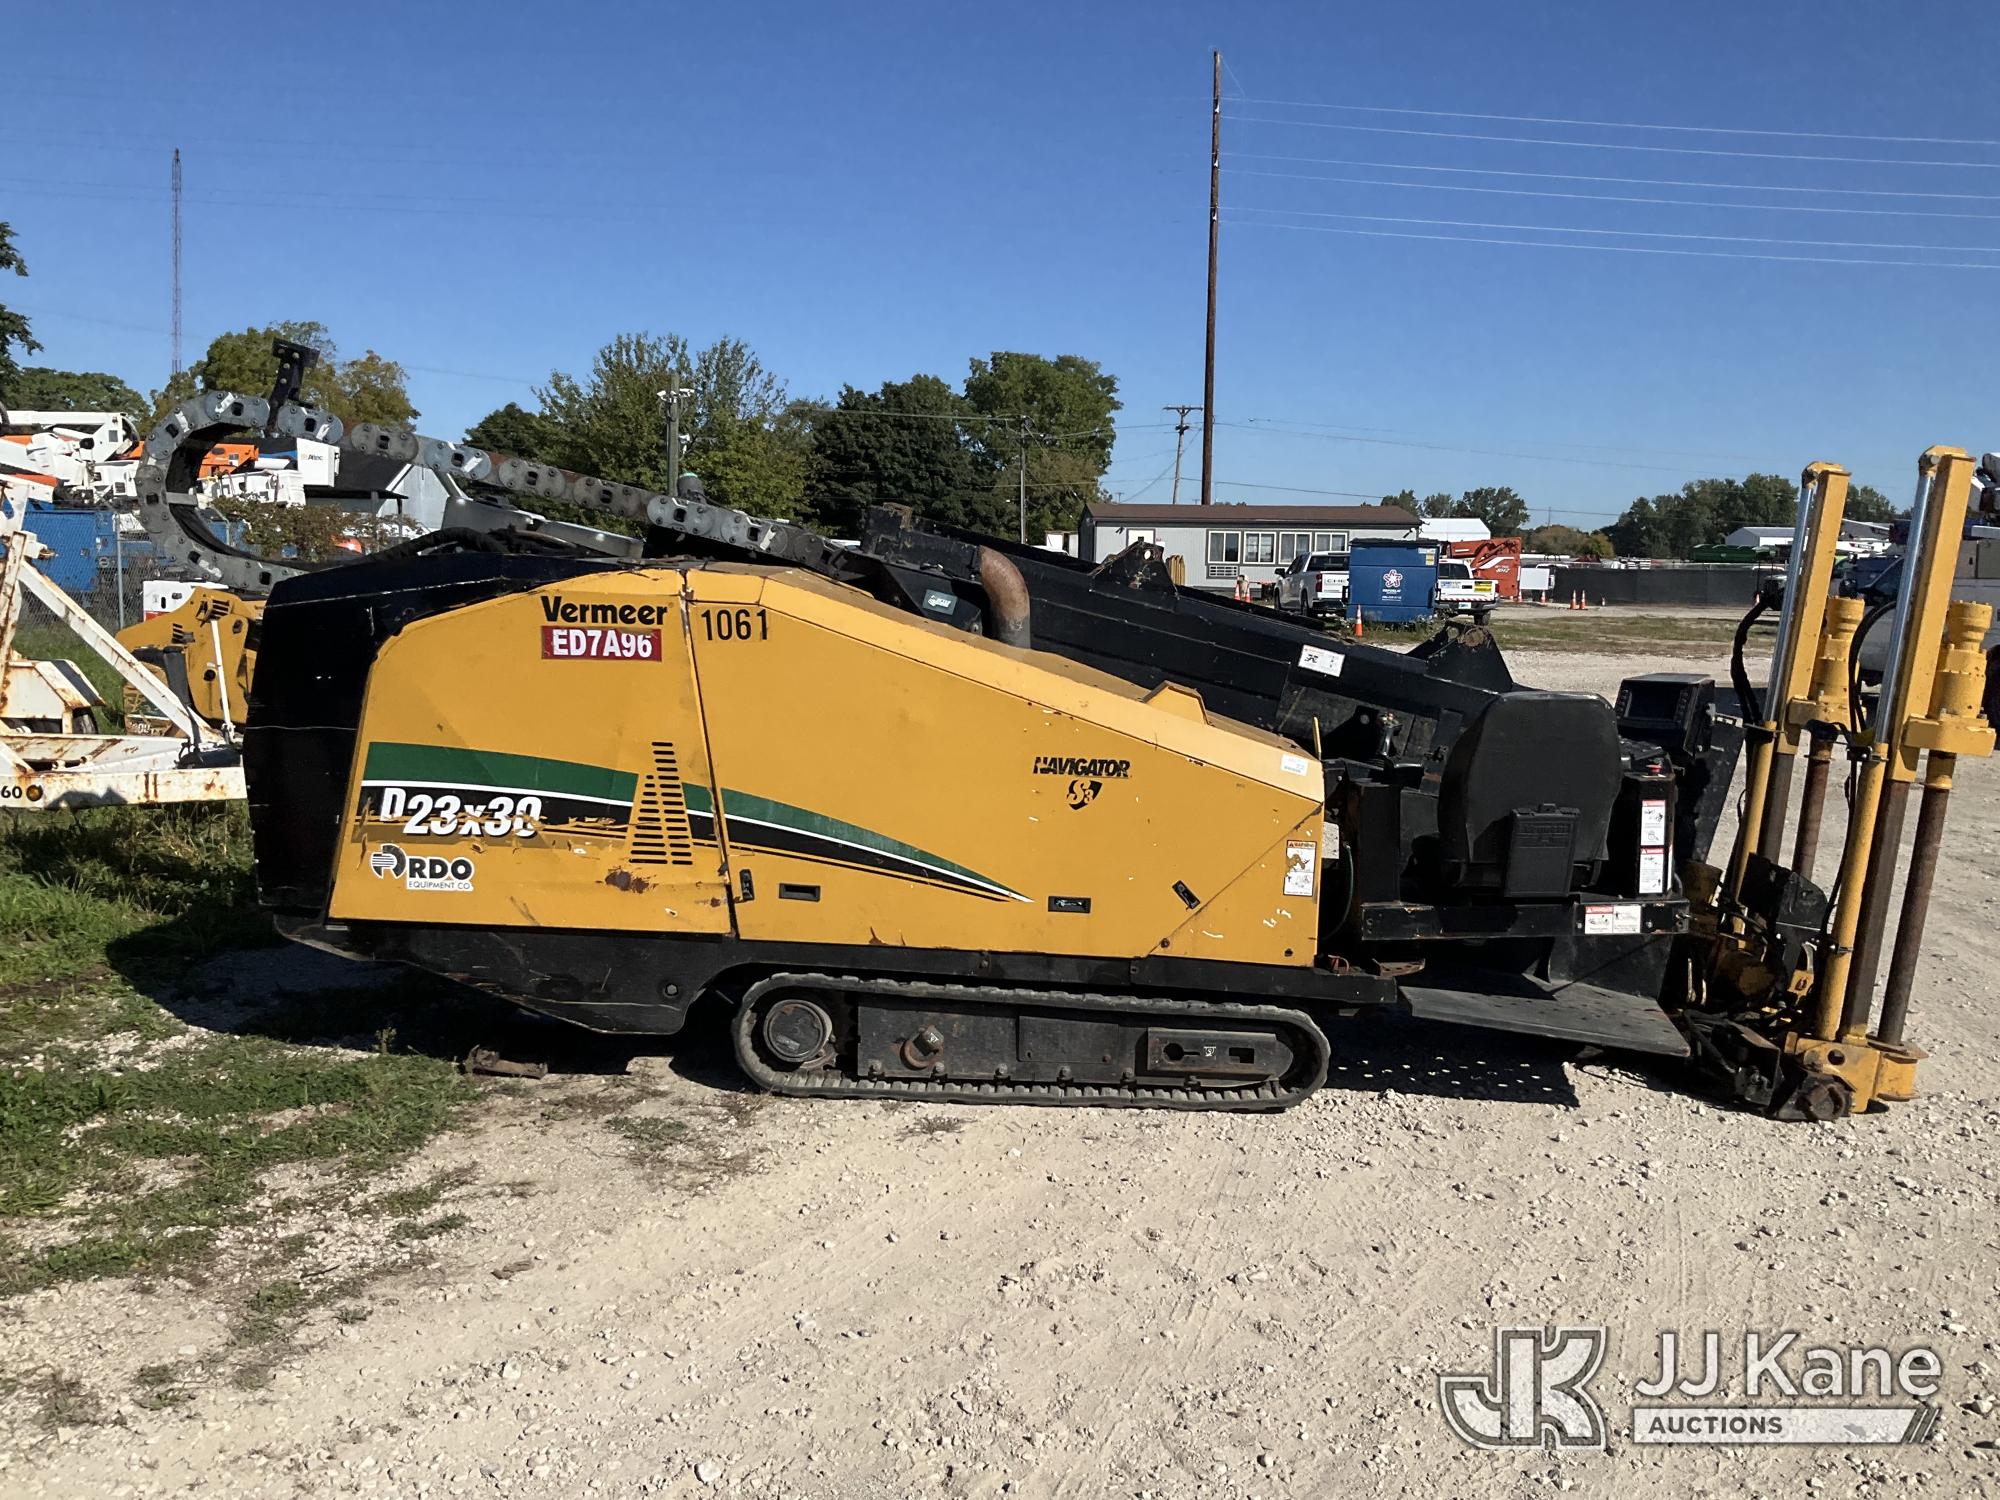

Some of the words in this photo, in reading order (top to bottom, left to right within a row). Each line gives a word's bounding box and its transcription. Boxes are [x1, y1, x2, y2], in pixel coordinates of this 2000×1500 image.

[540, 595, 668, 625] Vermeer
[701, 609, 768, 641] 1061
[552, 628, 653, 658] ED7A96
[1033, 757, 1130, 777] NAVIGATOR
[1, 785, 23, 799] 60
[380, 787, 542, 837] D23x30
[408, 880, 455, 889] EQUIPMENT
